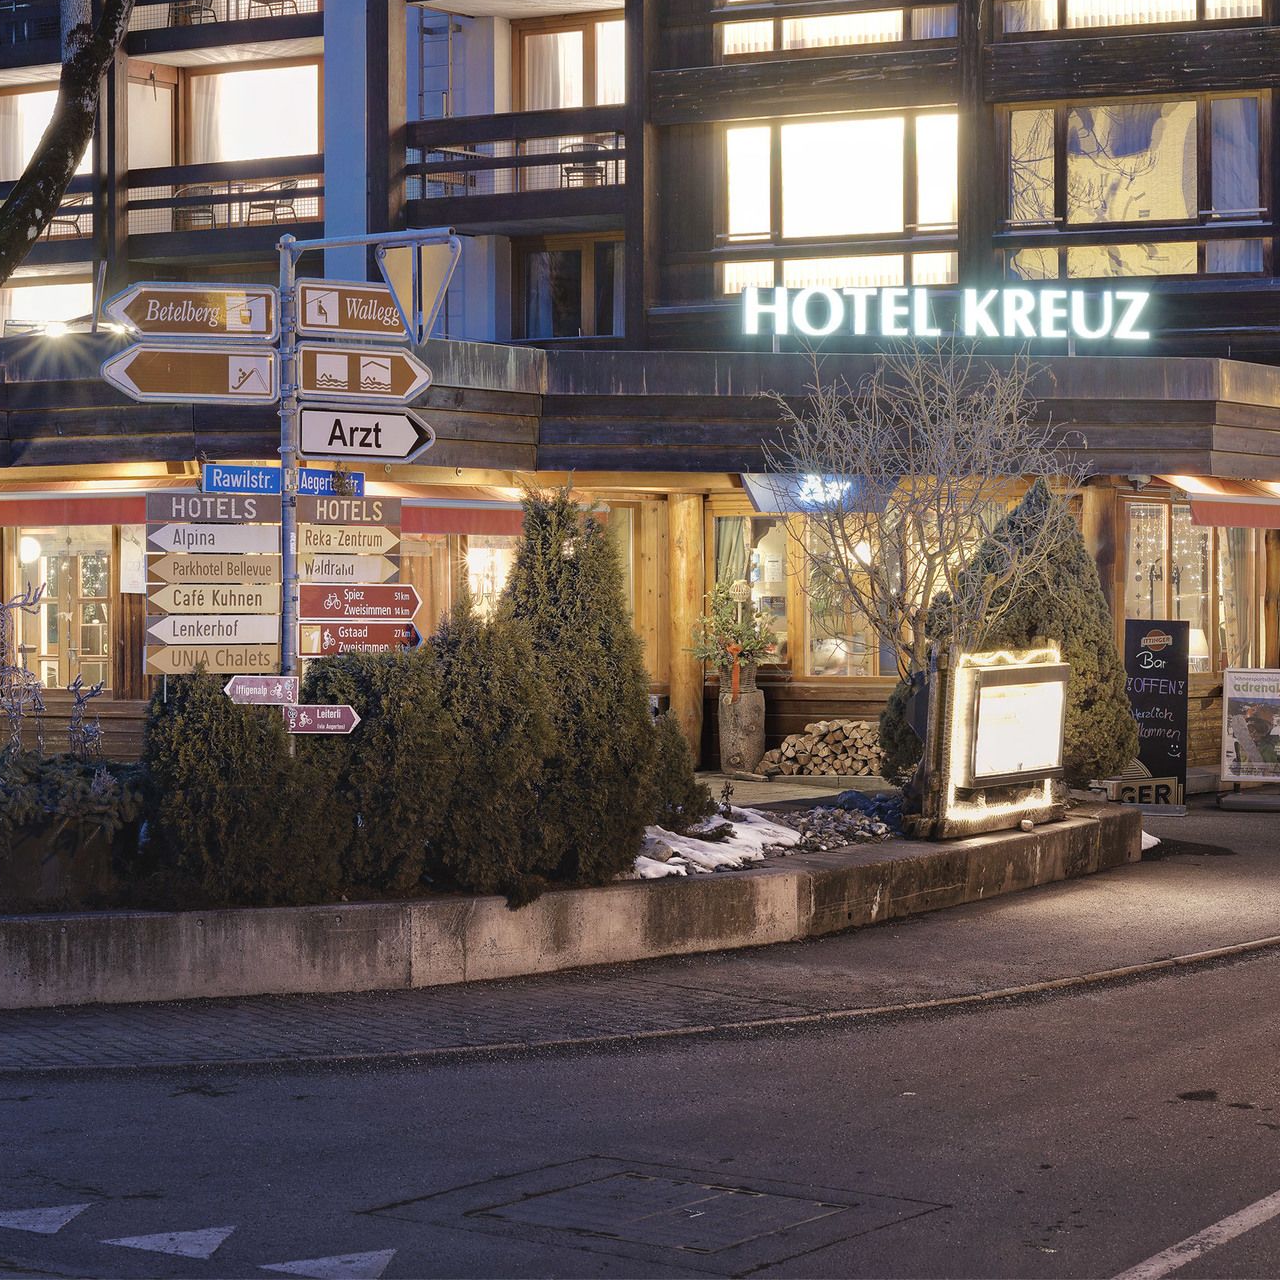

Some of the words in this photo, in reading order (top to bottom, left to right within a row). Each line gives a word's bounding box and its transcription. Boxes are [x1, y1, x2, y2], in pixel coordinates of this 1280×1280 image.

[146, 299, 220, 326] Betelberg
[345, 297, 400, 325] Wallegg
[742, 286, 941, 336] HOTEL
[963, 288, 1151, 339] KREUZ
[328, 418, 382, 448] Arzt
[213, 468, 273, 489] Rawilstr.
[301, 471, 361, 494] Aegertstr.
[172, 497, 257, 519] HOTELS
[316, 499, 383, 521] HOTELS
[173, 528, 216, 550] Alpina
[173, 561, 224, 576] Parkhotel
[226, 561, 272, 576] Bellevue
[173, 589, 205, 607] Café
[212, 589, 262, 607] Kuhnen
[344, 588, 365, 602] Spiez
[344, 604, 392, 616] Zweisimmen
[172, 620, 239, 637] Lenkerhof
[338, 626, 368, 638] Gstaad
[338, 641, 389, 653] Zweisimmen
[171, 649, 210, 667] UNIA
[215, 648, 271, 667] Chalets
[1135, 650, 1166, 669] Bar
[286, 691, 293, 700] 3
[289, 719, 296, 728] 5
